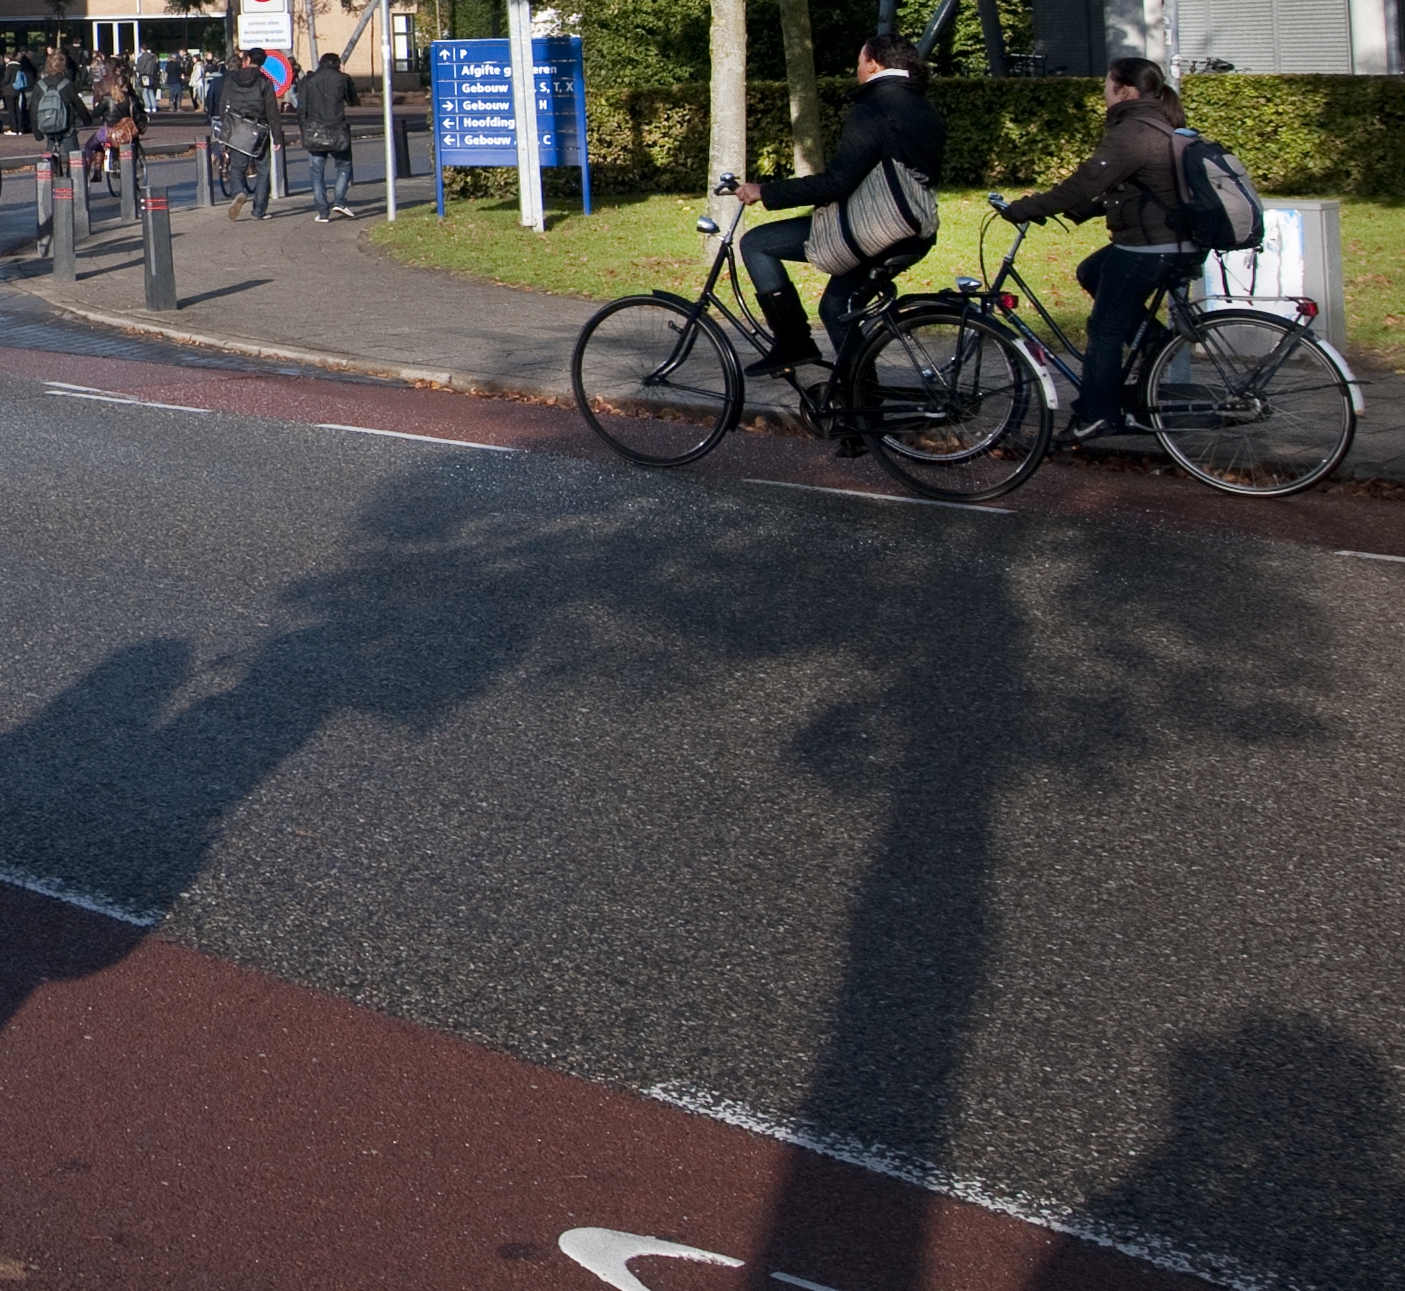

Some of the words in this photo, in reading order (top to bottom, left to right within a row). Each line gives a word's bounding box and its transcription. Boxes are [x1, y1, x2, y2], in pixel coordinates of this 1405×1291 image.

[460, 49, 468, 59] P
[461, 64, 501, 77] Afgifte
[461, 82, 509, 93] Gebouw
[565, 81, 574, 92] X
[462, 100, 510, 111] Gebouw
[539, 99, 548, 110] H
[464, 134, 512, 145] Gebouw
[543, 135, 551, 145] C
